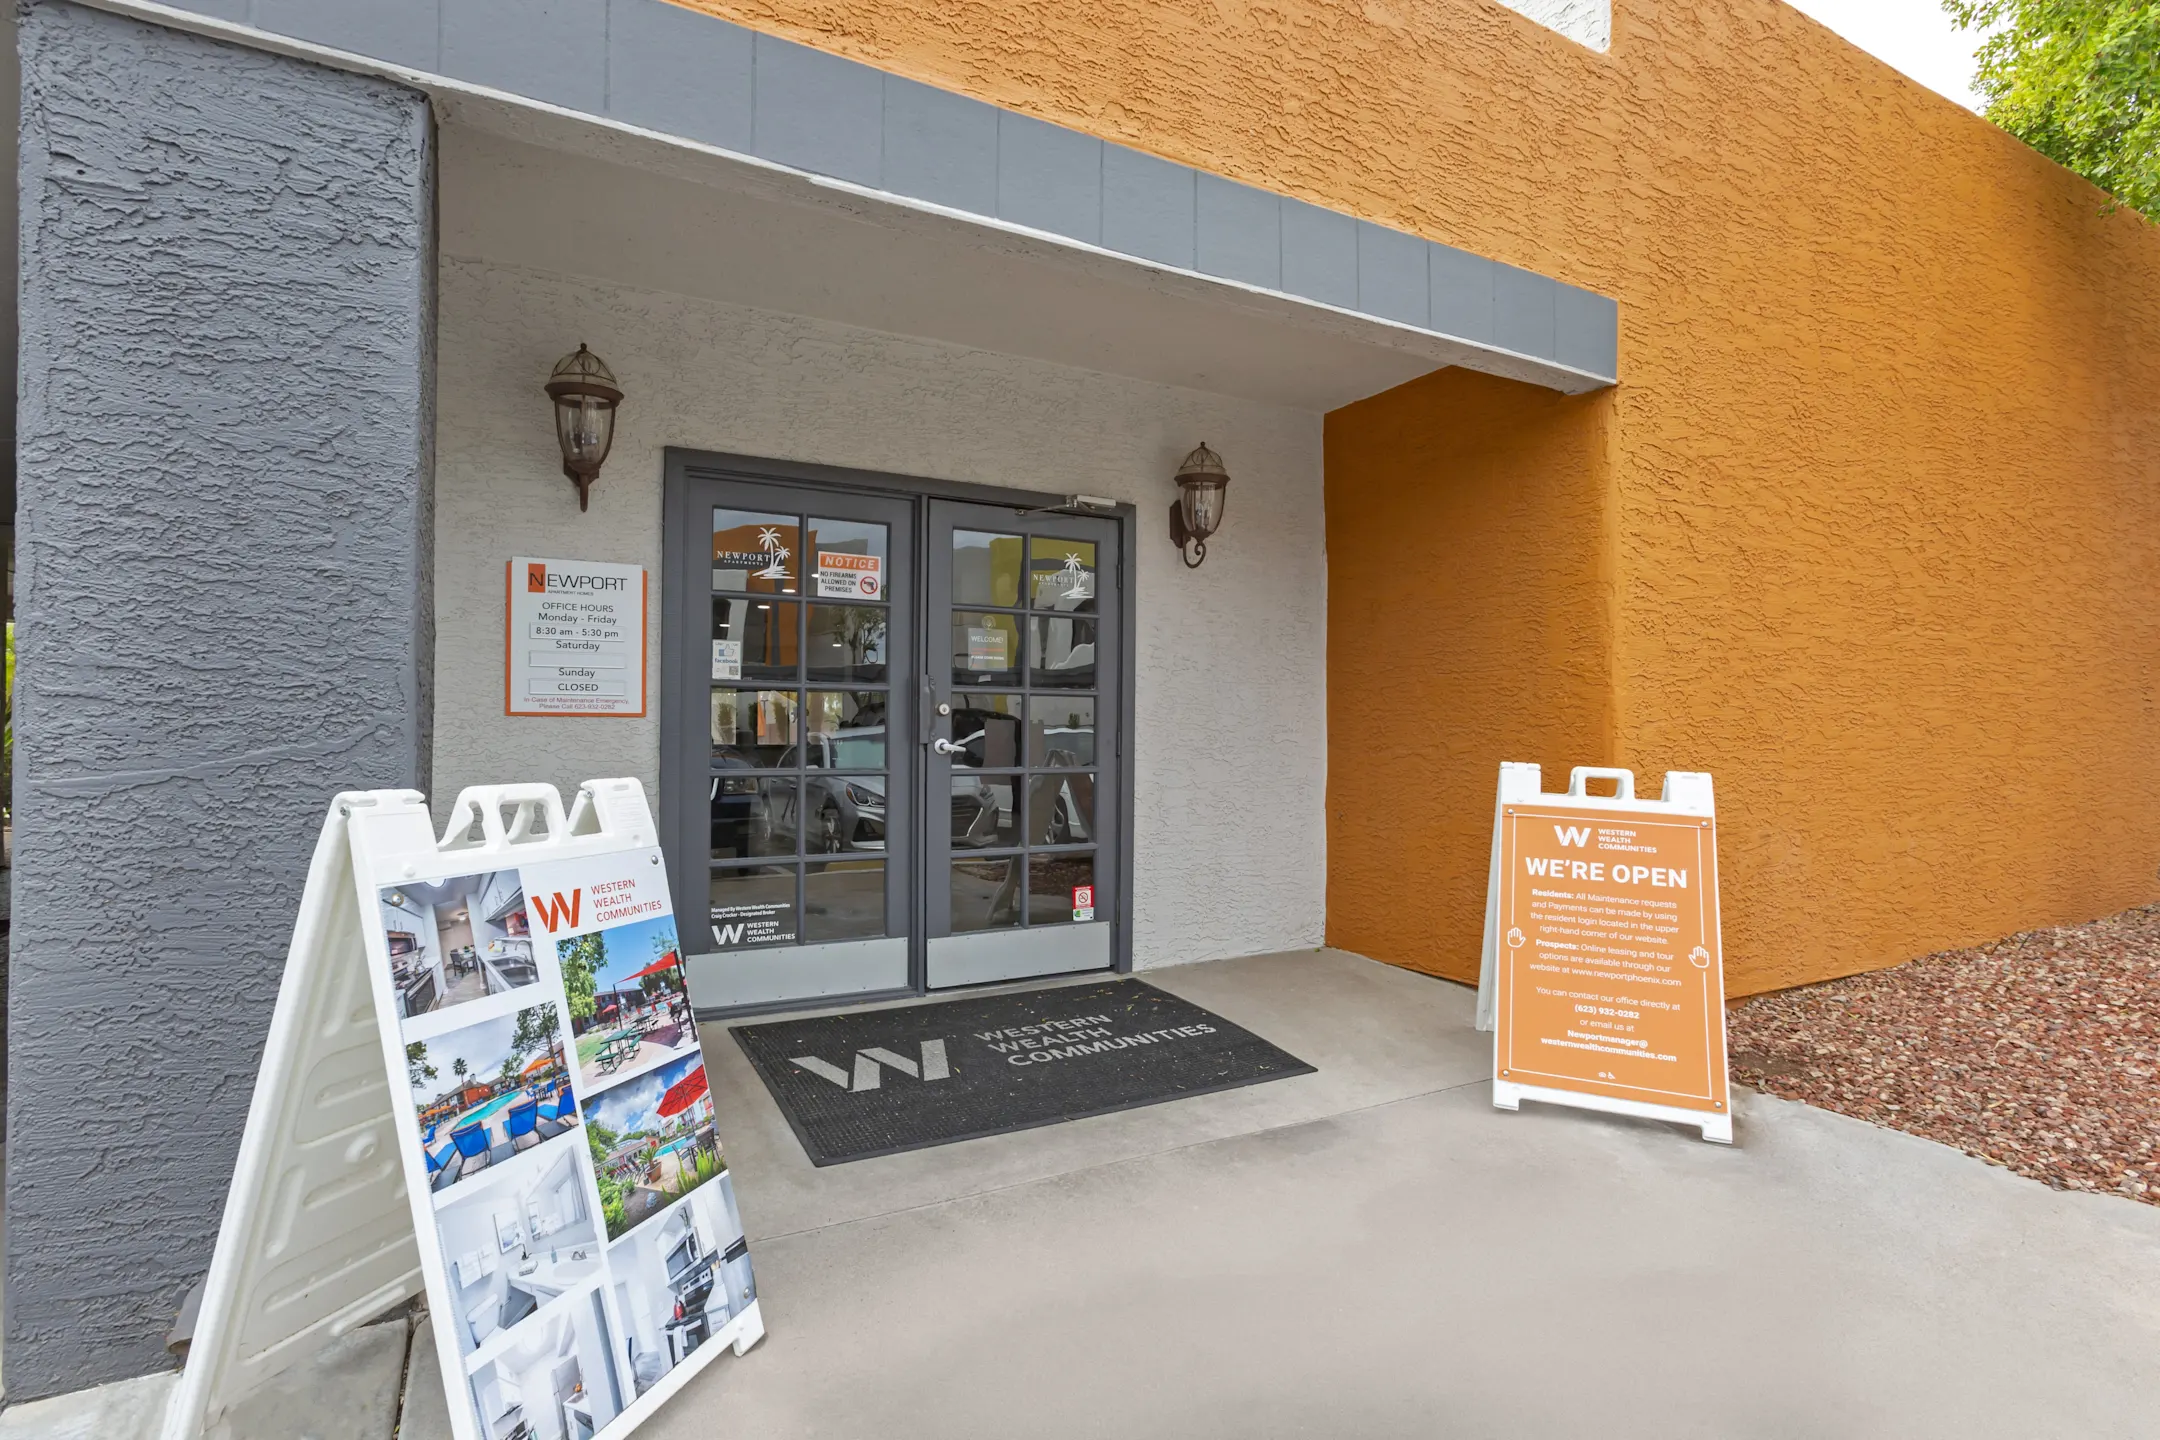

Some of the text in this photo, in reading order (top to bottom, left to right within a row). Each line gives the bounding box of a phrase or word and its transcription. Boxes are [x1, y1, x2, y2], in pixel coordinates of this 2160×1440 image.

[717, 550, 770, 562] NEWPORT
[825, 555, 875, 569] NOTICE
[529, 572, 628, 591] NEWPORT
[821, 578, 847, 586] ALLOWED
[830, 571, 857, 579] FIREARMS
[1033, 574, 1073, 583] NEWPORT
[542, 602, 614, 613] OFFICE HOURS
[538, 612, 578, 624] Monday
[587, 615, 617, 626] Friday
[536, 627, 556, 635] 8:30
[582, 628, 601, 637] 5:30
[604, 631, 619, 639] pm
[556, 640, 600, 652] Saturday
[558, 667, 596, 679] Sunday
[557, 683, 599, 691] CLOSED
[1598, 828, 1636, 837] WESTERN
[1598, 835, 1631, 844] WEALTH
[1598, 843, 1657, 853] COMMUNITIES
[1525, 857, 1687, 889] WE'RE OPEN
[591, 879, 636, 895] WESTERN
[593, 893, 632, 909] WEALTH
[1532, 888, 1574, 899] Residents:
[1587, 894, 1640, 905] Maintenance
[1641, 900, 1677, 909] requests
[596, 900, 662, 923] COMMUNITIES
[1548, 901, 1587, 912] Payments
[1589, 906, 1604, 914] can
[1605, 907, 1616, 915] be
[1618, 909, 1641, 917] made
[1643, 910, 1653, 920] by
[1654, 912, 1678, 922] using
[747, 921, 779, 929] WESTERN
[1530, 912, 1679, 934] the resident login located in the upper
[747, 928, 774, 936] WEALTH
[747, 933, 795, 943] COMMUNITIES
[1540, 925, 1579, 935] right-hand
[1581, 929, 1607, 938] corner
[1634, 934, 1669, 944] website.
[1535, 938, 1579, 950] Prospects:
[1581, 943, 1607, 953] Online
[1608, 946, 1637, 958] leasing
[1656, 952, 1674, 960] tour
[1539, 952, 1569, 961] options
[1585, 957, 1621, 967] available
[1622, 960, 1654, 972] through
[1656, 965, 1671, 973] our
[1529, 963, 1560, 973] website
[1571, 968, 1682, 986] www.newportphoenix.com
[1536, 986, 1551, 995] You
[1569, 991, 1599, 1001] contact
[1615, 996, 1638, 1005] office
[1640, 999, 1670, 1010] directly
[1574, 1004, 1640, 1019] (623) 932-0282
[972, 1013, 1112, 1042] WESTERN
[1590, 1020, 1612, 1029] email
[1614, 1023, 1624, 1031] us
[987, 1027, 1111, 1053] WEALTH
[1007, 1022, 1217, 1067] COMMUNITIES
[1567, 1029, 1648, 1048] Newportmanager@
[1541, 1037, 1677, 1062] westernwealthcommunities.com
